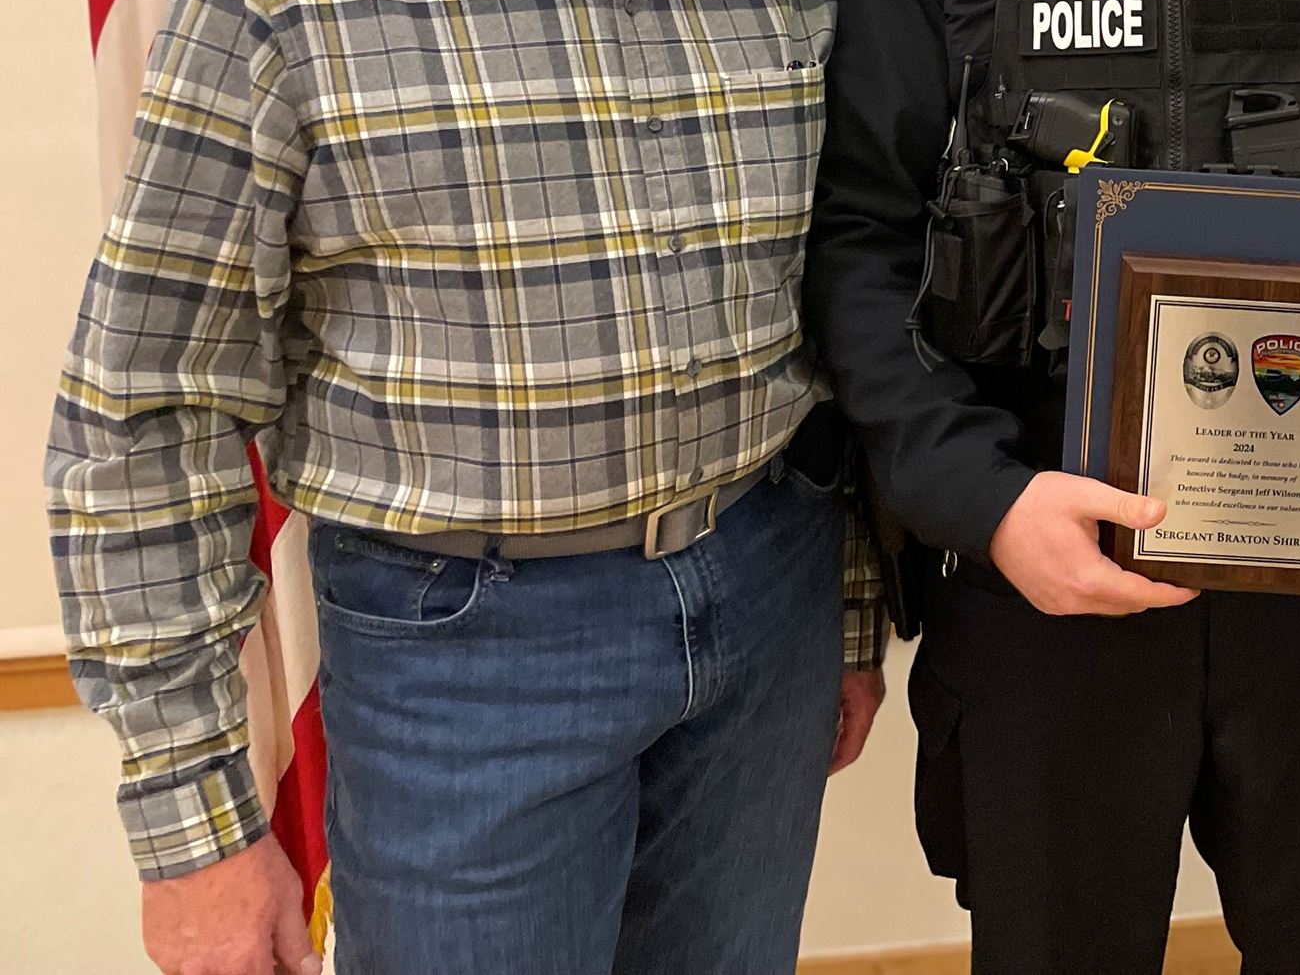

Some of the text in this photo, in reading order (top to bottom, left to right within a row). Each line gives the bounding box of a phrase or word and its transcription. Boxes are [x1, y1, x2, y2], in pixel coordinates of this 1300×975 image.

[1033, 0, 1144, 50] POLICE
[1233, 443, 1255, 453] 2024
[1218, 458, 1252, 466] dedicated
[1289, 475, 1298, 484] of
[1177, 483, 1216, 493] Detective
[1217, 486, 1253, 496] Sergeant
[1255, 488, 1271, 497] Jeff
[1155, 528, 1214, 542] SERGEANT
[1217, 531, 1271, 545] BRAXTON
